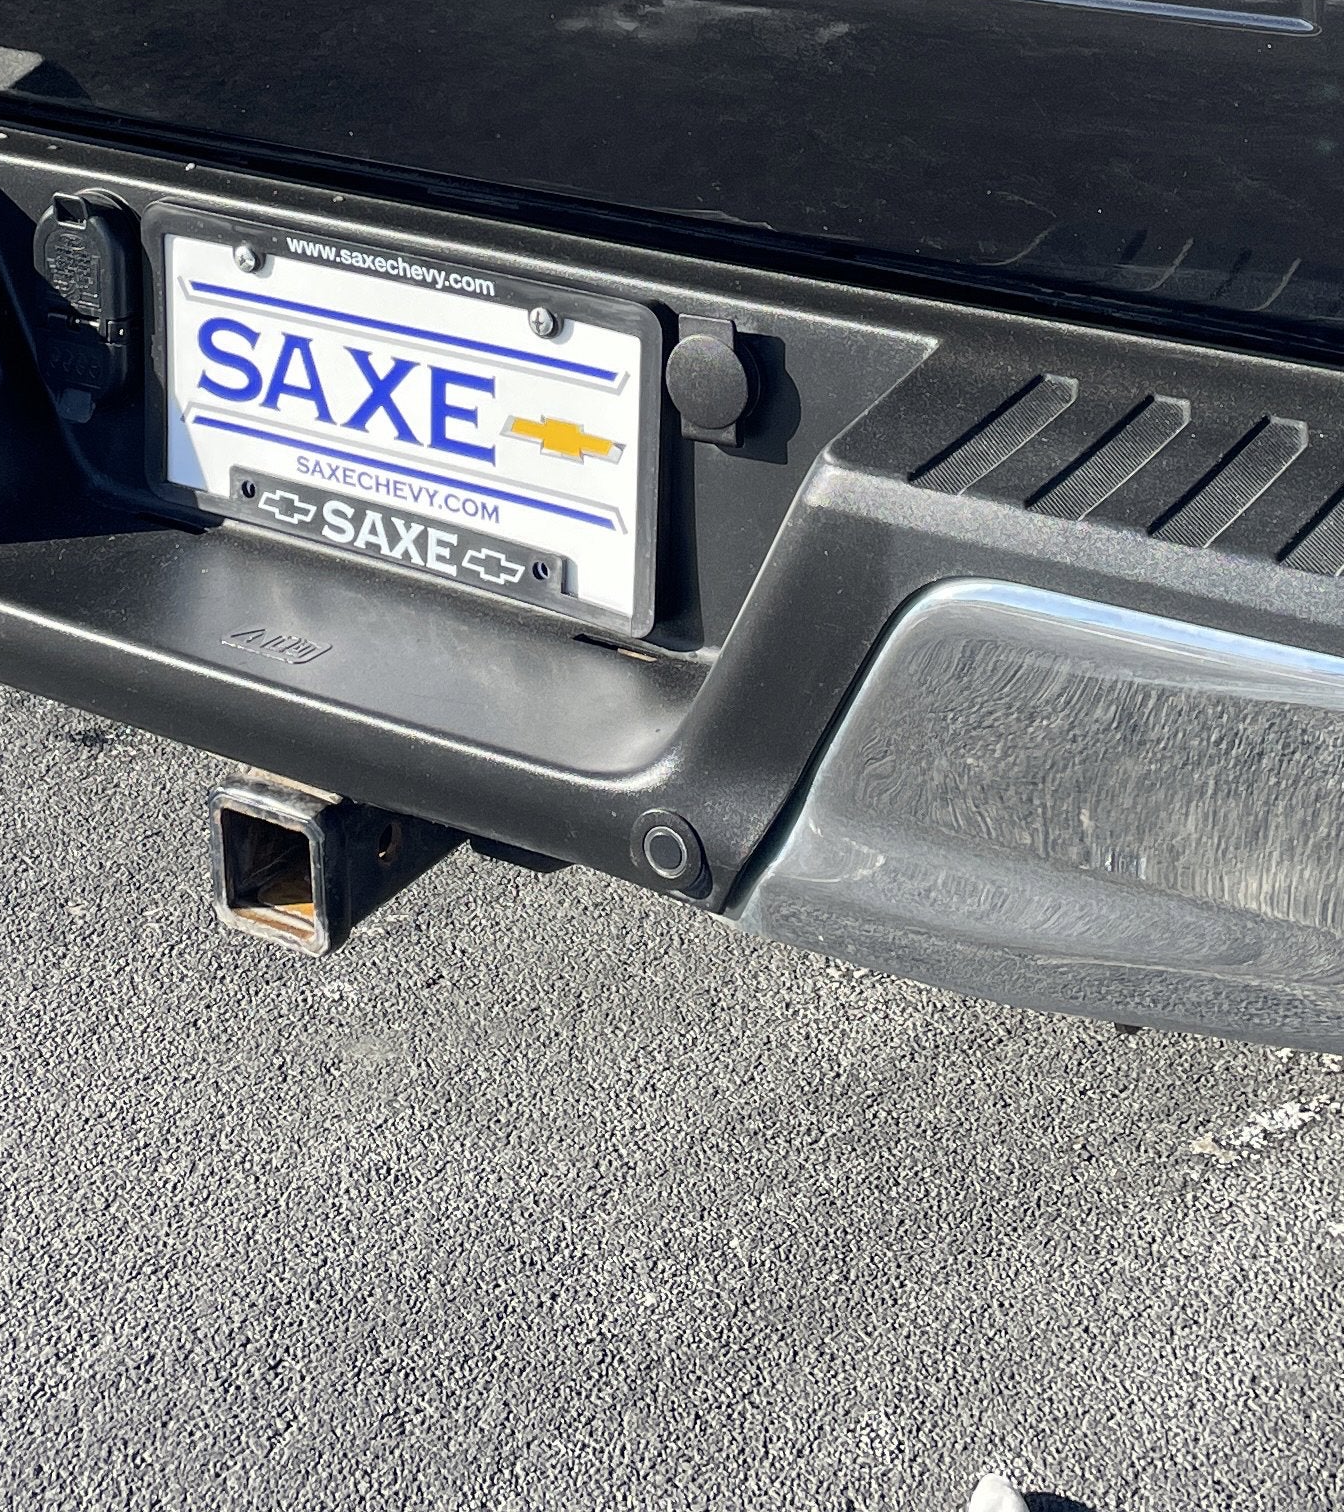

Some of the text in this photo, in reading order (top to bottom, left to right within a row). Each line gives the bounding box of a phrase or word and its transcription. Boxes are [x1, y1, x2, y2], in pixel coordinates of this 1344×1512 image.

[286, 236, 495, 297] www.saxechevy.com
[196, 317, 497, 467] SAXE
[295, 455, 500, 525] SAXECHEVY.COM
[321, 499, 458, 575] SAXE
